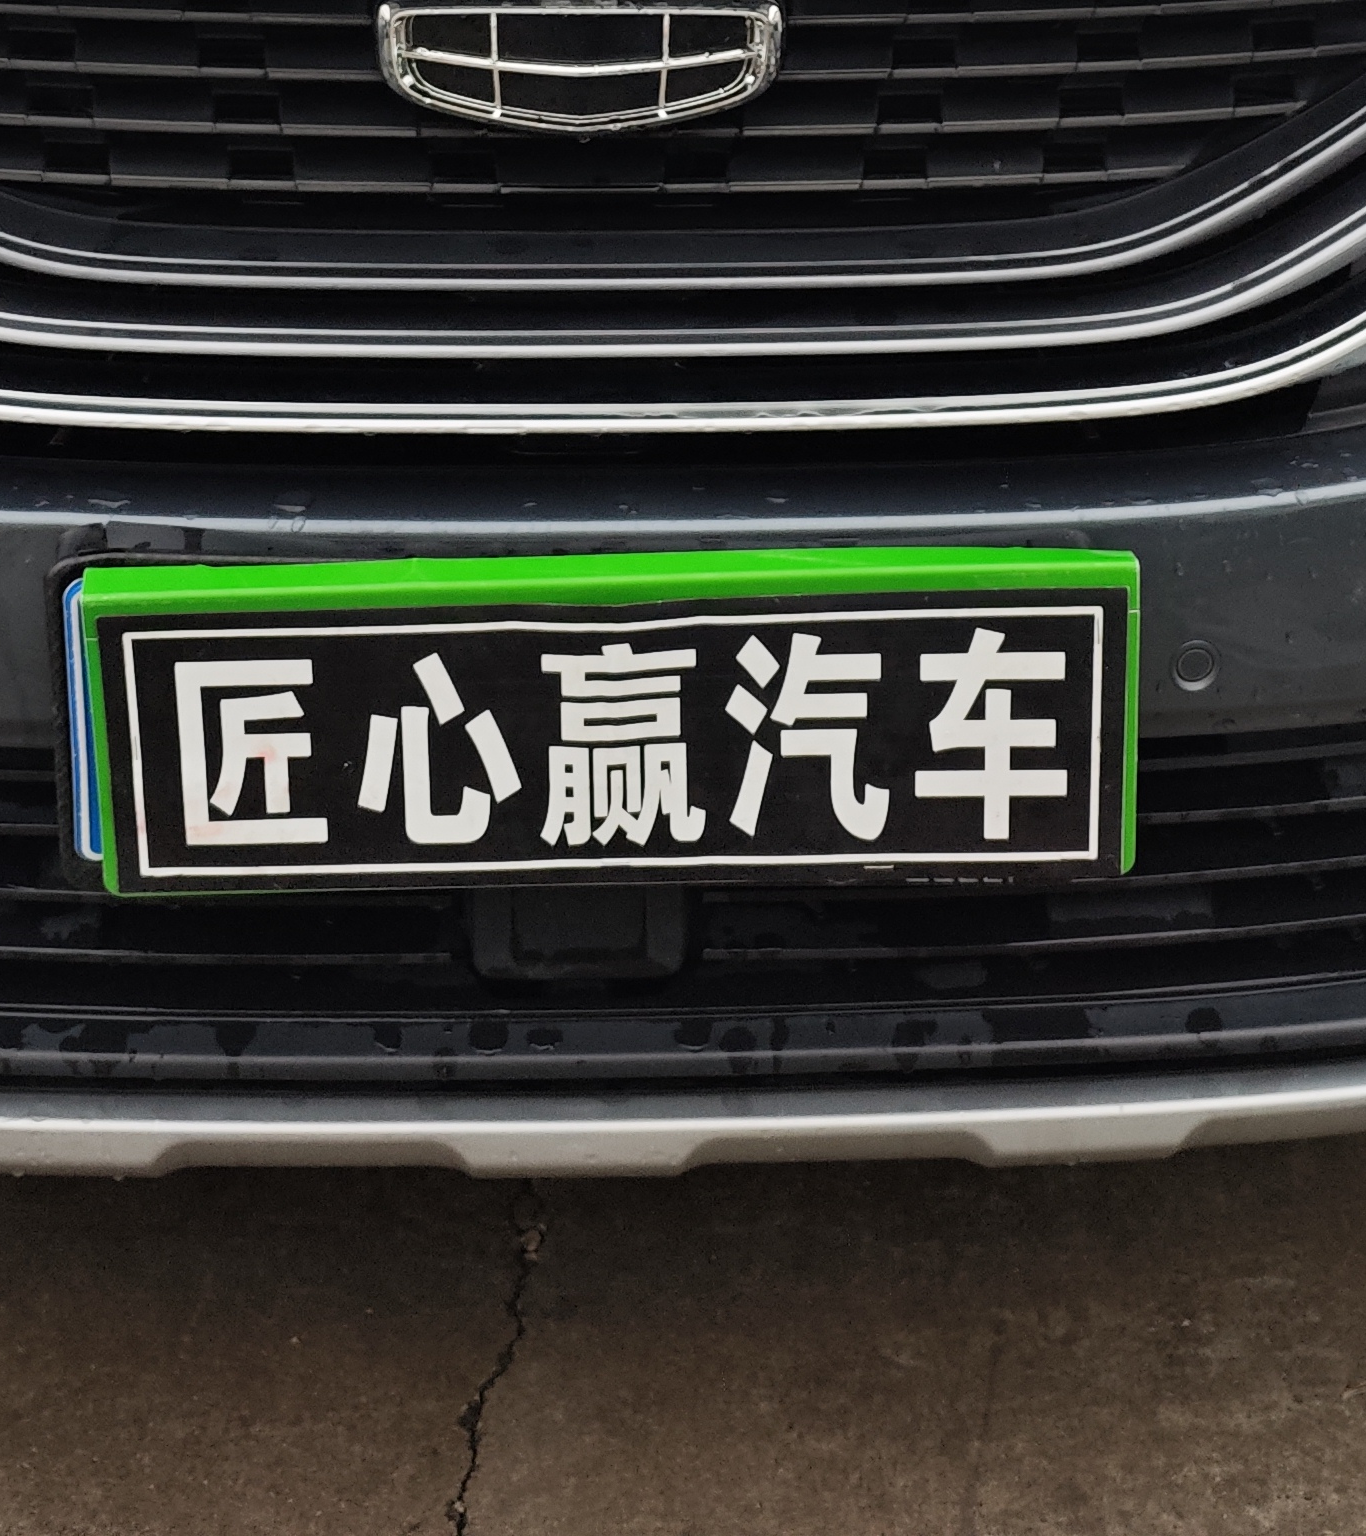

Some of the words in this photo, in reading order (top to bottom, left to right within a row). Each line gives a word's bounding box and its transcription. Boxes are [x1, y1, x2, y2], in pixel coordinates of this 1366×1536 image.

[173, 627, 1070, 848] 匠心赢汽车
